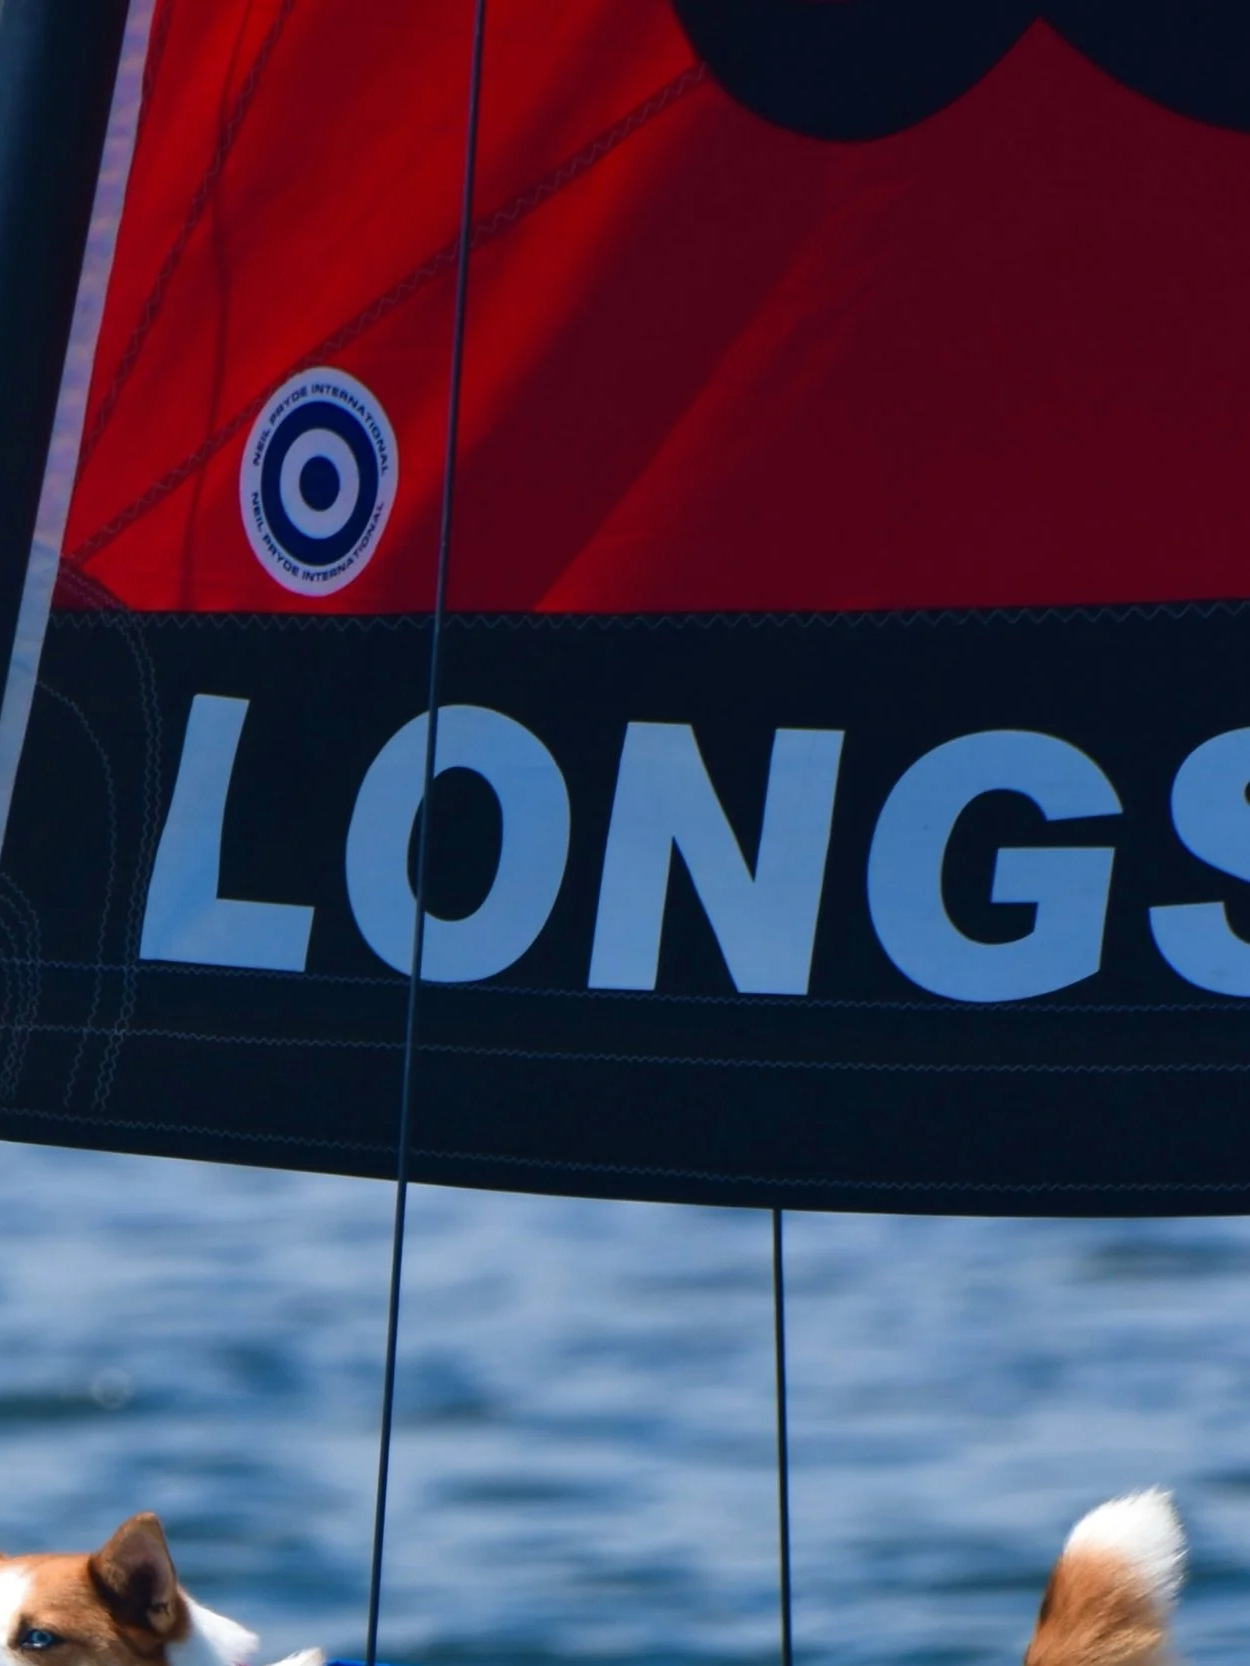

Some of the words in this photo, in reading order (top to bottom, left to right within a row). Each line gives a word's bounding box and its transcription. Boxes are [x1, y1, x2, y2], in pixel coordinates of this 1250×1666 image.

[253, 428, 271, 466] NEIL
[269, 386, 308, 427] PRYDE
[311, 383, 389, 475] INTERNATIONAL
[251, 492, 264, 534] NEIL
[262, 534, 300, 578] PRYDE
[302, 501, 385, 583] INTERNATIONAL
